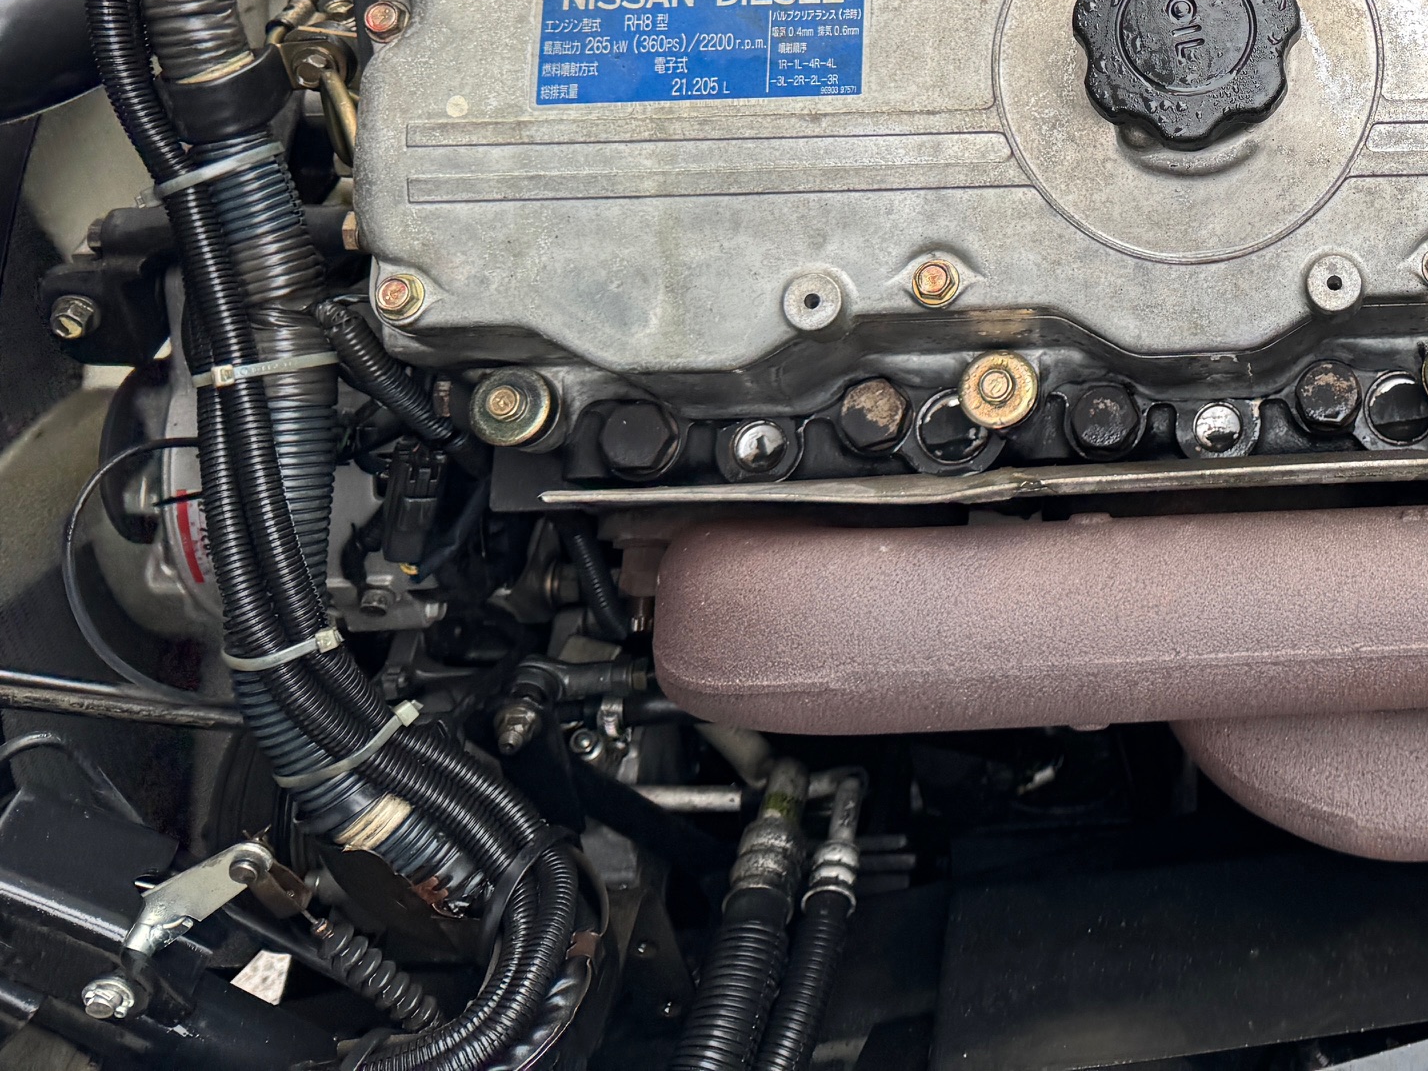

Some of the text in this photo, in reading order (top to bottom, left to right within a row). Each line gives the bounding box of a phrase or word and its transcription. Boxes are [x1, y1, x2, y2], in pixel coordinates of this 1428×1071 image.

[544, 13, 669, 33] エンジン型式 RH8 型
[788, 26, 815, 37] 0.4mm
[834, 24, 860, 36] 0.6mm
[543, 40, 581, 55] 最高出力
[585, 36, 611, 54] 265
[613, 40, 629, 53] kW
[541, 56, 688, 77] 燃料噴射方式 電子式
[778, 57, 837, 70] 1R-1L-4R-4L
[540, 77, 730, 100] 総排気量 21.205 L
